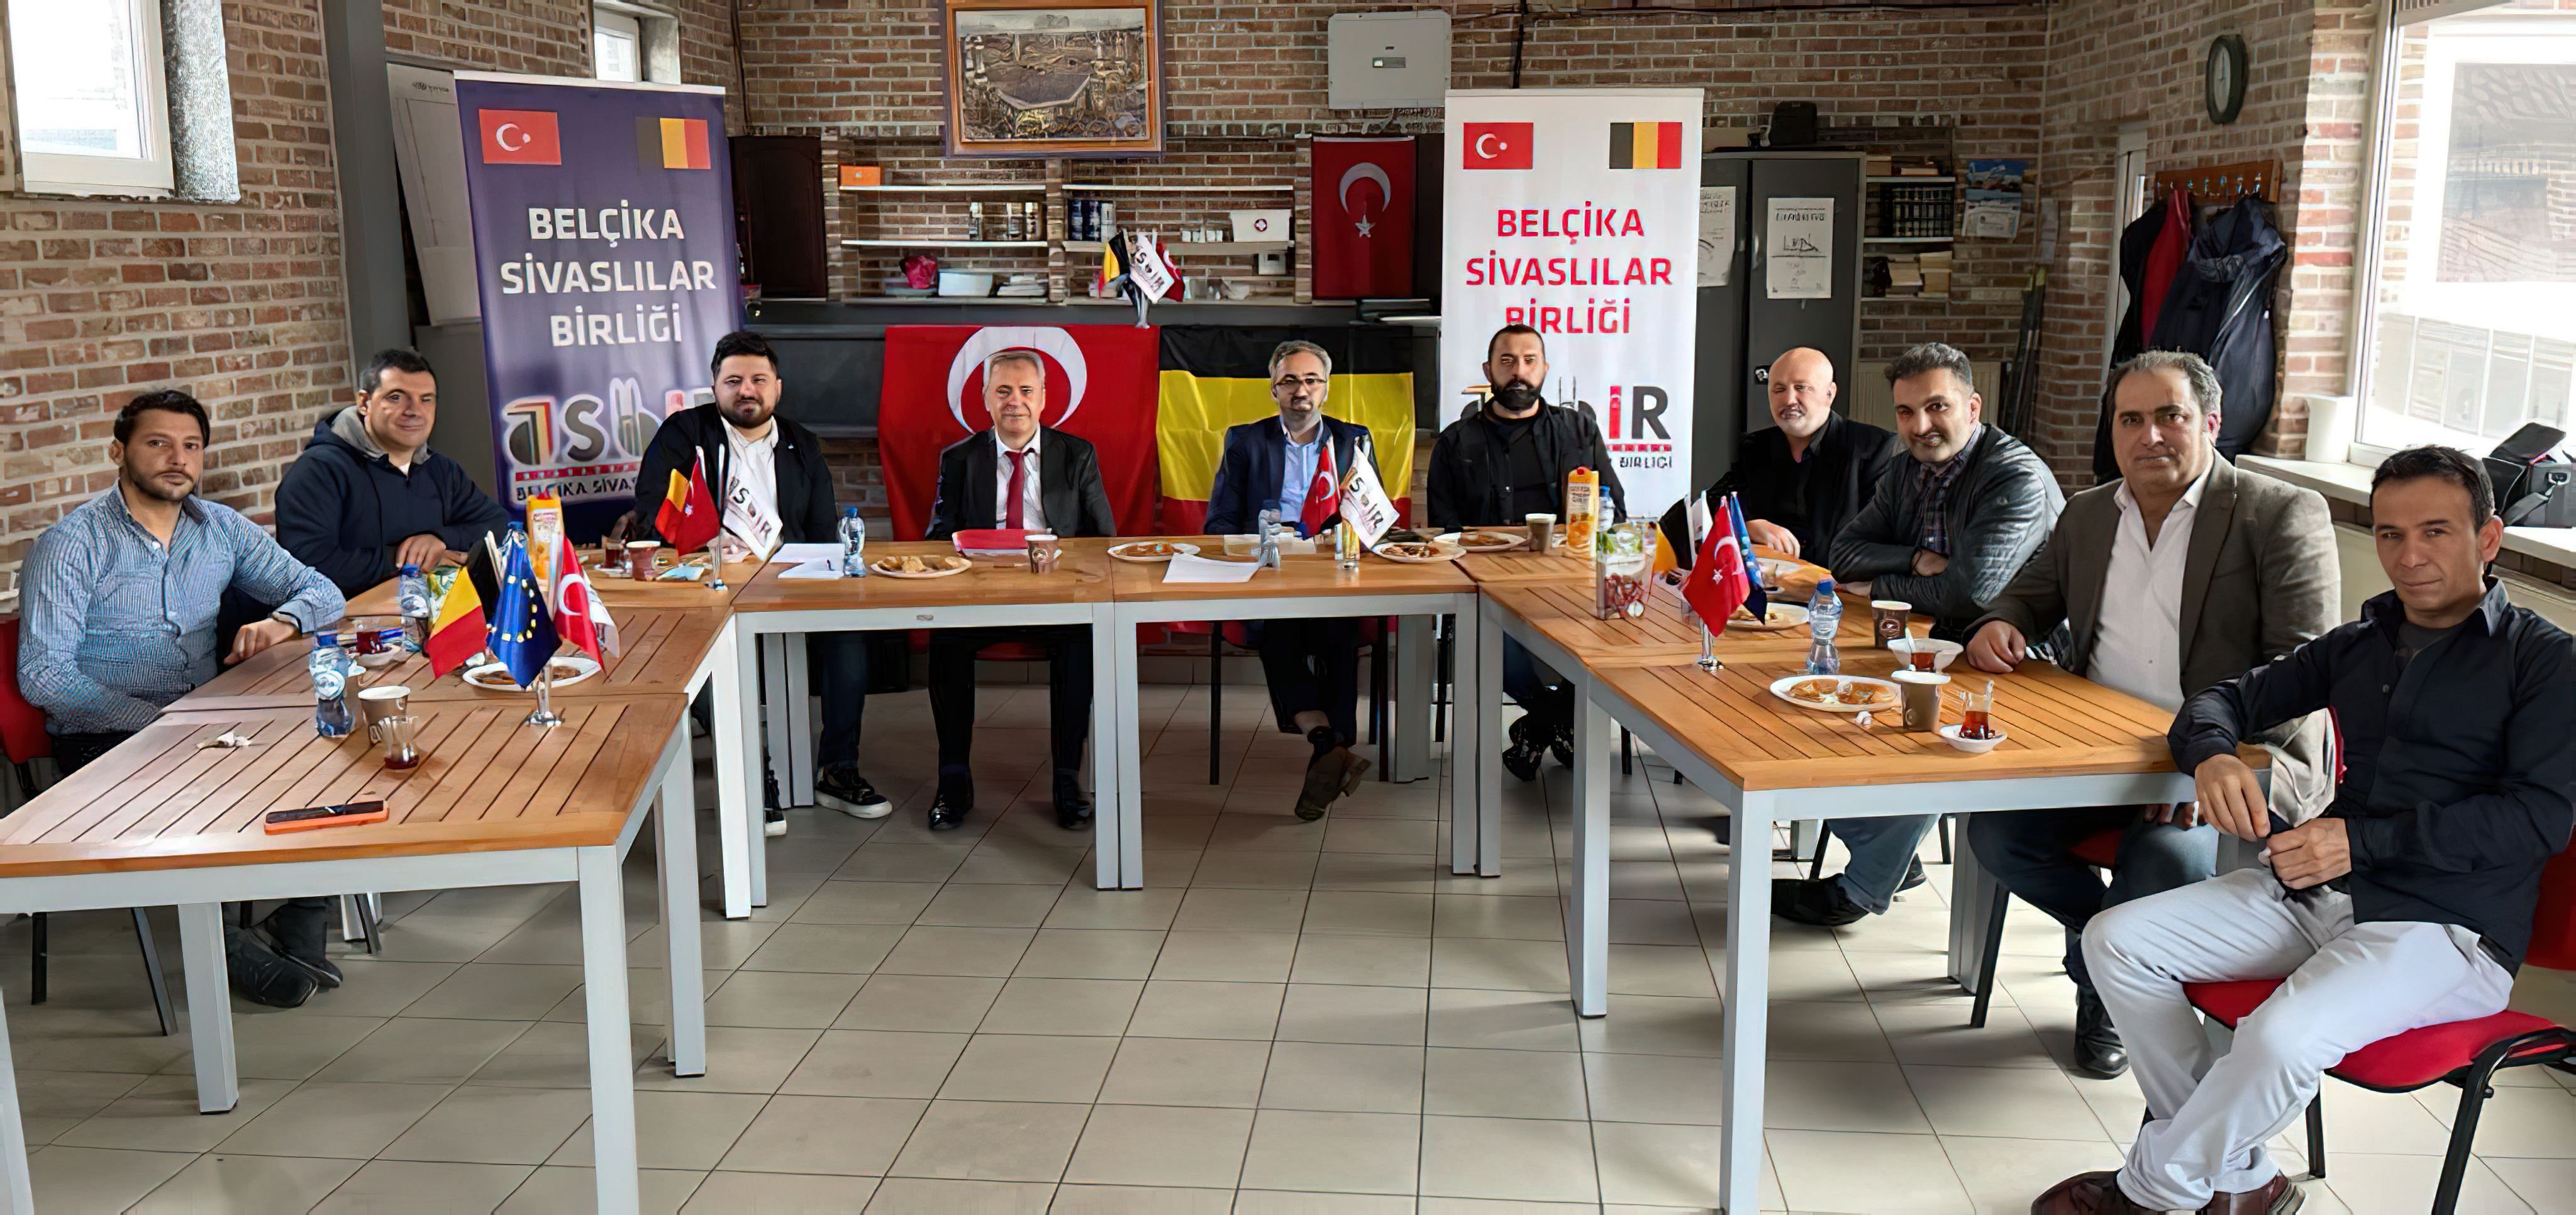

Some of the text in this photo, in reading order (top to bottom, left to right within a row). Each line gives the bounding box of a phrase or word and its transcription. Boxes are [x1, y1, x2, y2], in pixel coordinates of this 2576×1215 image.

[528, 199, 684, 248] BELÇİKA
[1497, 201, 1645, 245] BELÇİKA
[501, 252, 717, 294] SİVASLILAR
[1466, 249, 1673, 286] SİVASLILAR
[550, 302, 682, 347] BİRLİĞİ
[1505, 297, 1630, 333] BİRLİĞİ
